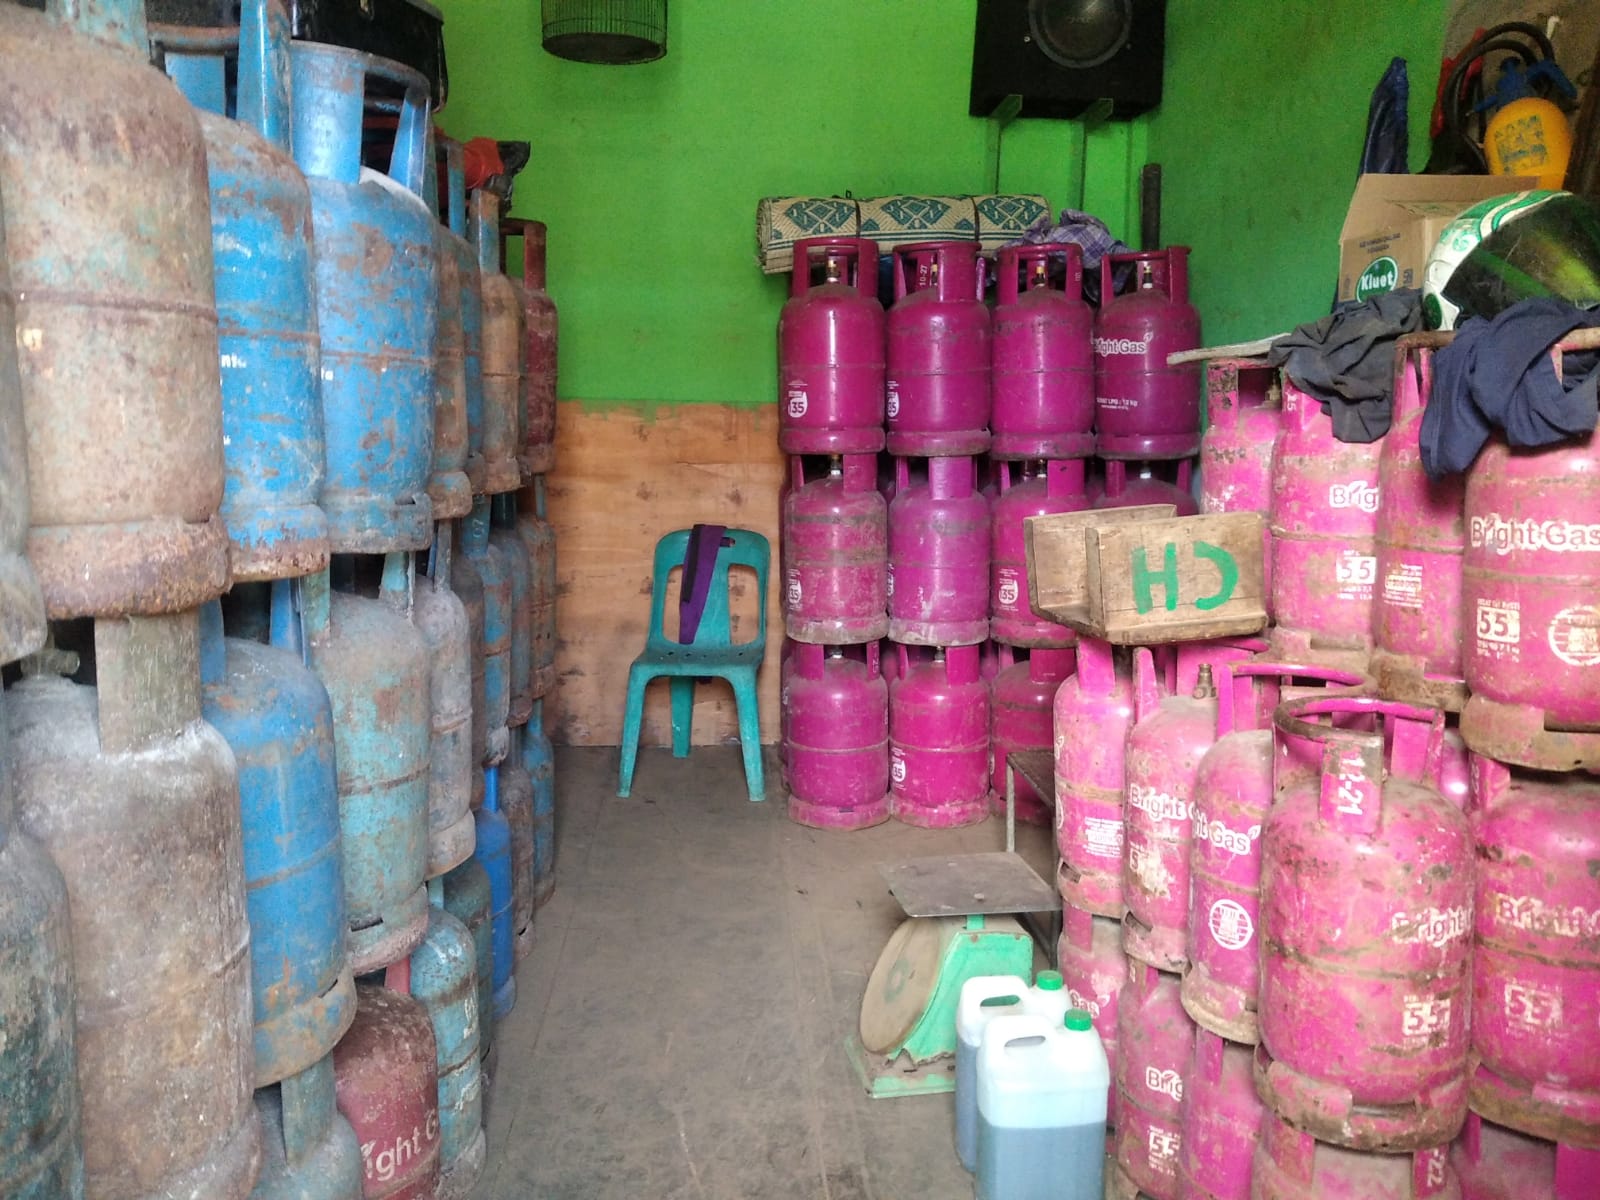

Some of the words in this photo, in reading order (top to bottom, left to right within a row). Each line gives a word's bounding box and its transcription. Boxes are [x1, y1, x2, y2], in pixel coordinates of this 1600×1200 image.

[1119, 339, 1147, 354] Gas
[792, 401, 805, 414] 35
[1329, 480, 1378, 512] Brig
[1471, 514, 1540, 555] Bright
[1002, 589, 1015, 600] 35
[1480, 610, 1509, 636] 55
[1130, 783, 1187, 821] Bright
[1209, 821, 1251, 855] Gas
[1146, 1066, 1183, 1101] Brig
